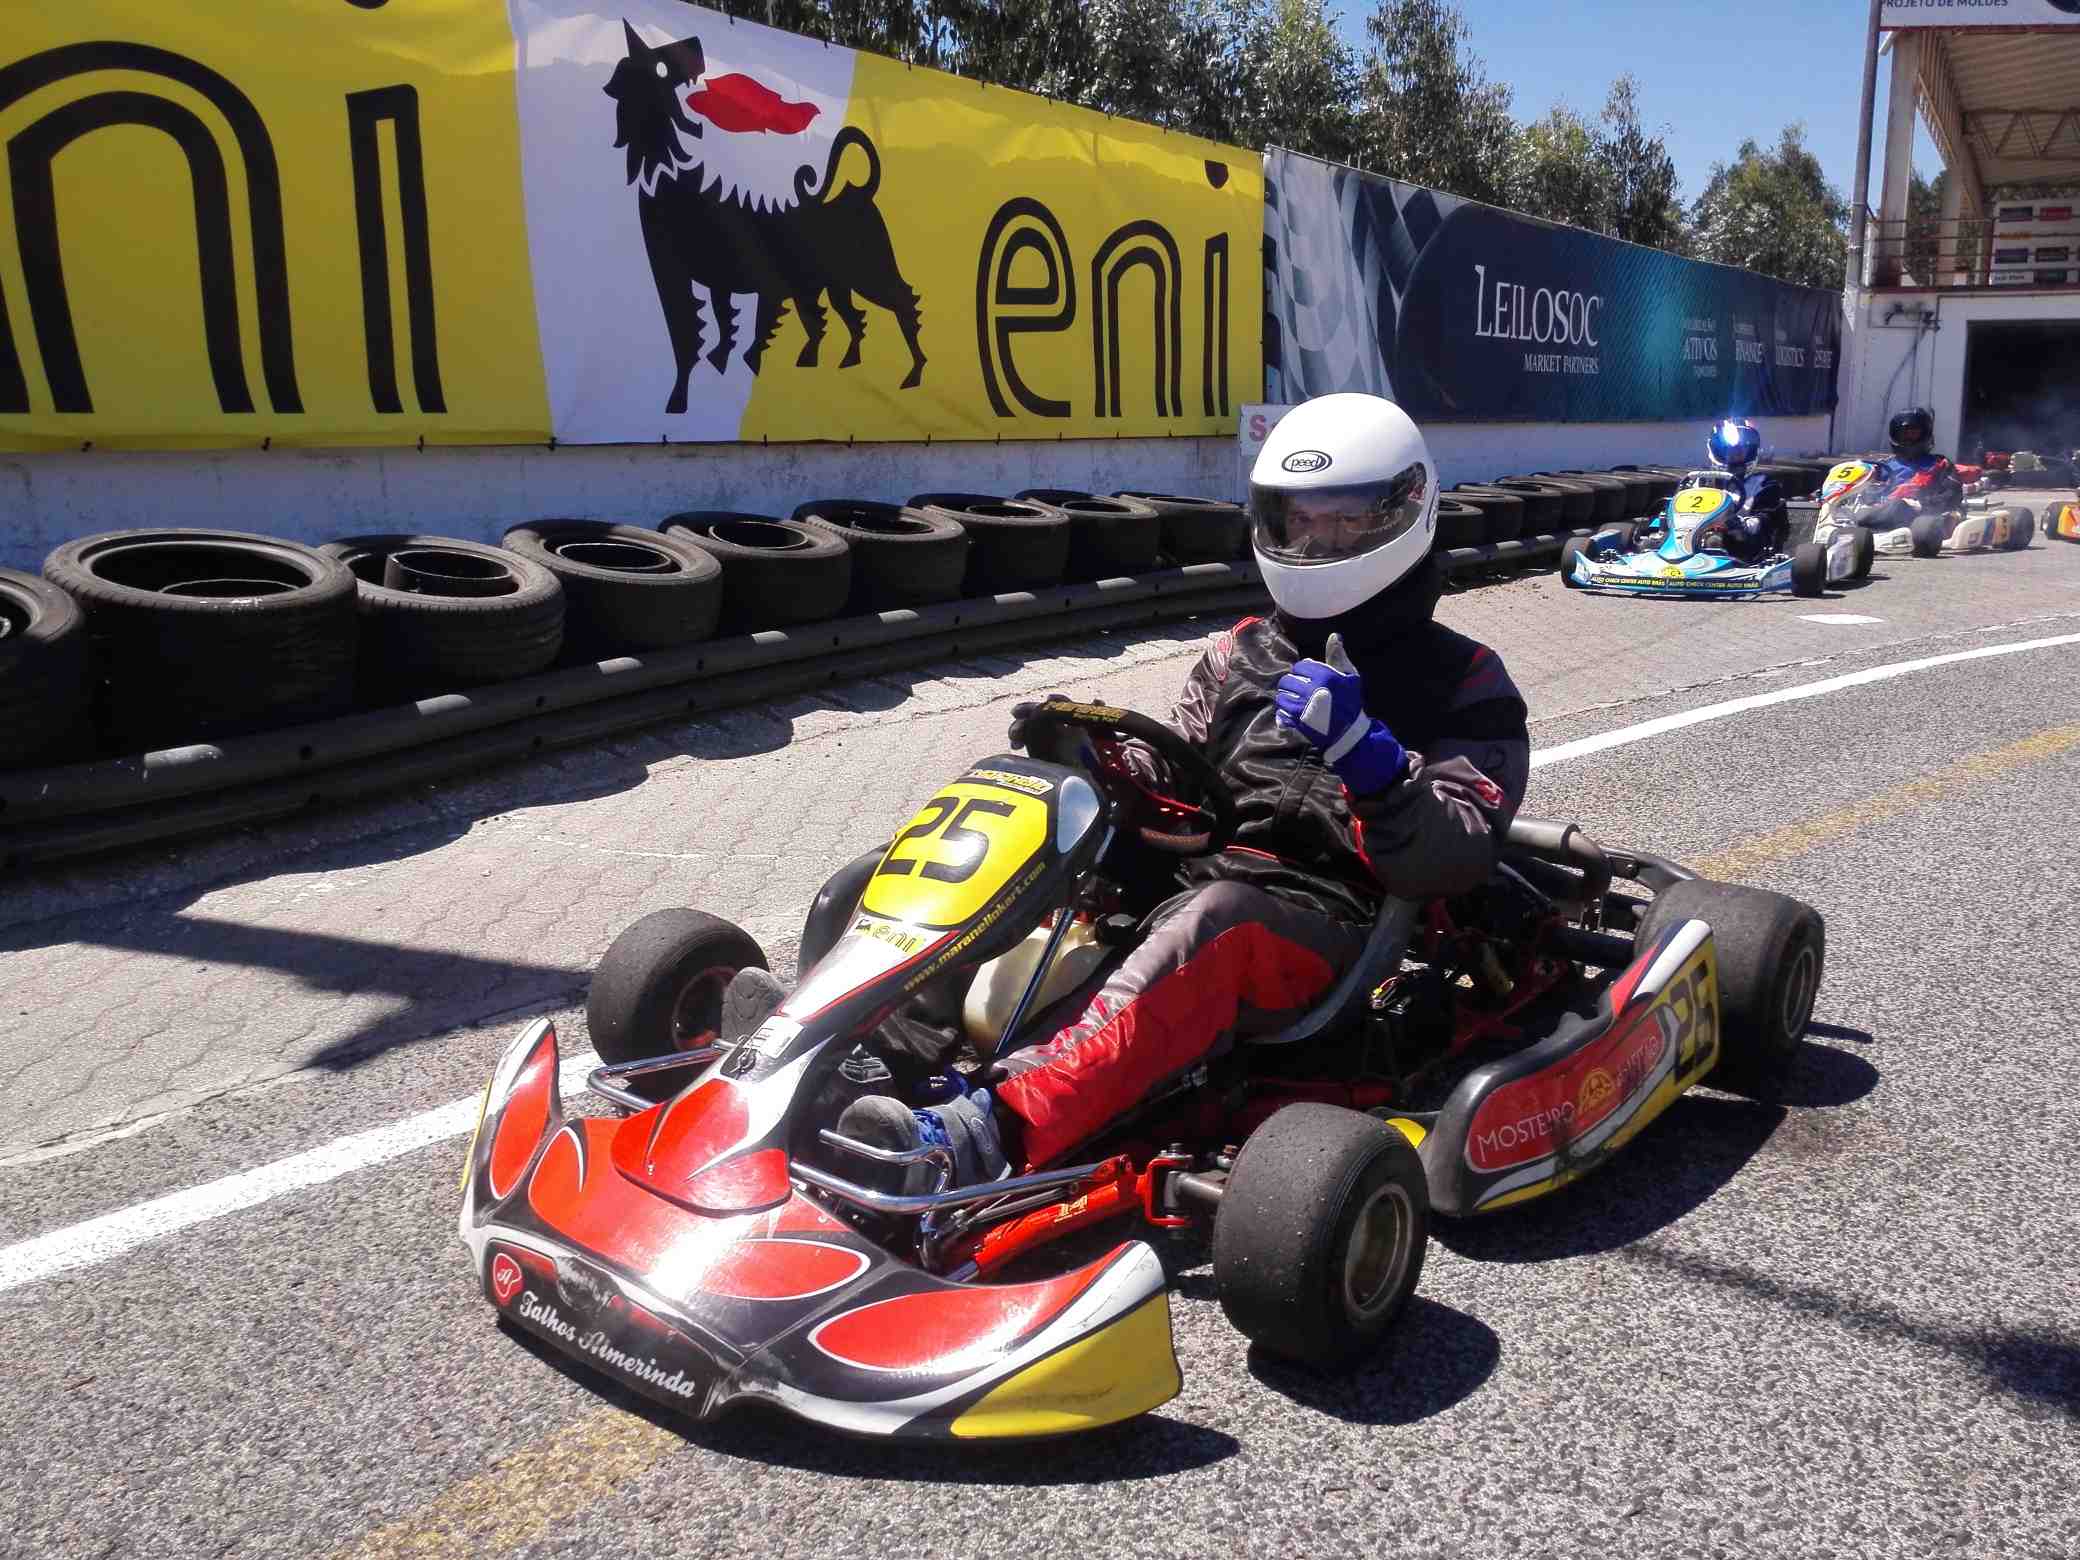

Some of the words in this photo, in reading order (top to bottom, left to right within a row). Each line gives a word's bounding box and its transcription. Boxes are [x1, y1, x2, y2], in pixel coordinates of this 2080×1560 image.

[975, 159, 1230, 418] eni
[1474, 263, 1600, 347] LEILOSOC
[1523, 353, 1562, 373] MARKET
[1563, 355, 1600, 375] PARTNERS
[1690, 495, 1704, 508] 2
[1837, 466, 1856, 479] 5
[875, 796, 1017, 884] 25
[872, 924, 918, 953] eni
[1667, 959, 1714, 1086] 25
[519, 1290, 577, 1342] Talhos
[578, 1330, 696, 1399] Almerinda
